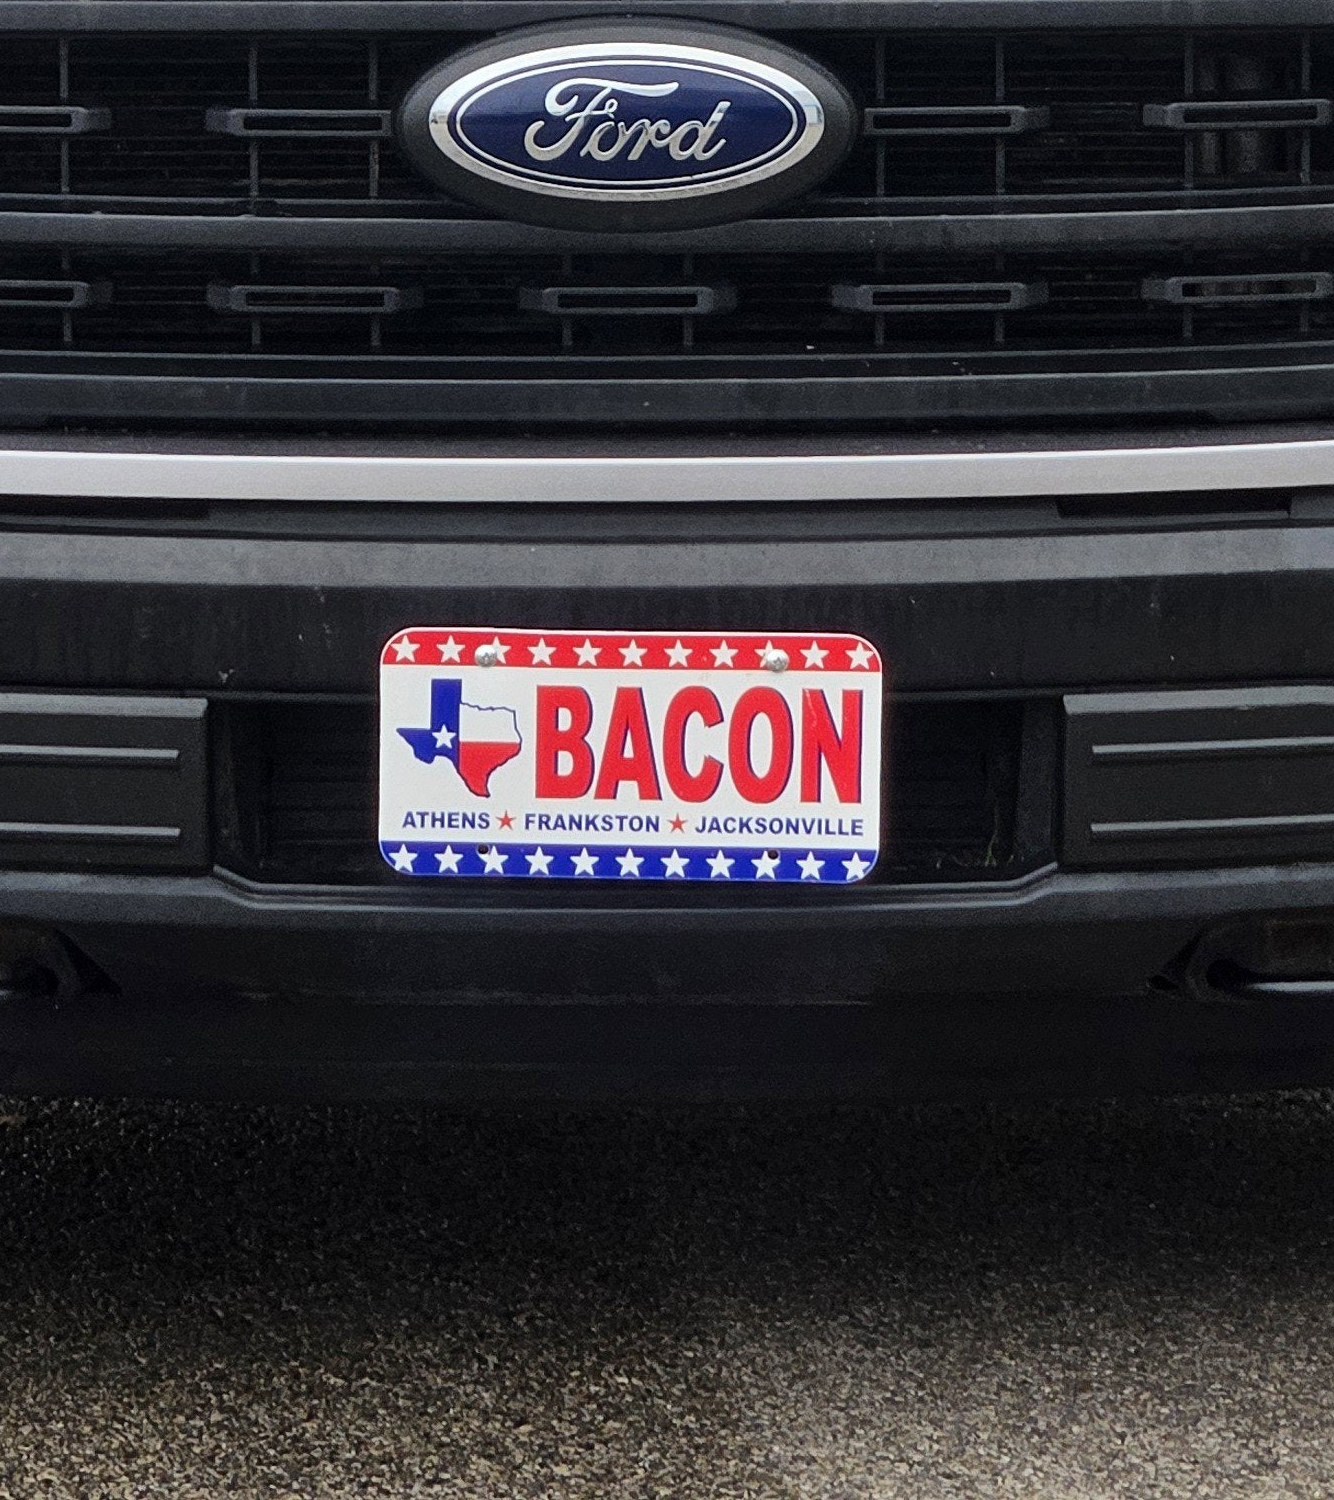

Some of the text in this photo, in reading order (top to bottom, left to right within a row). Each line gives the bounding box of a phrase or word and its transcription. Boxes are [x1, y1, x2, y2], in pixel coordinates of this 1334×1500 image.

[524, 77, 731, 161] Ford
[535, 685, 864, 804] BACON
[402, 811, 864, 836] ATHENS FRANKSTON JACKSONVILLE
